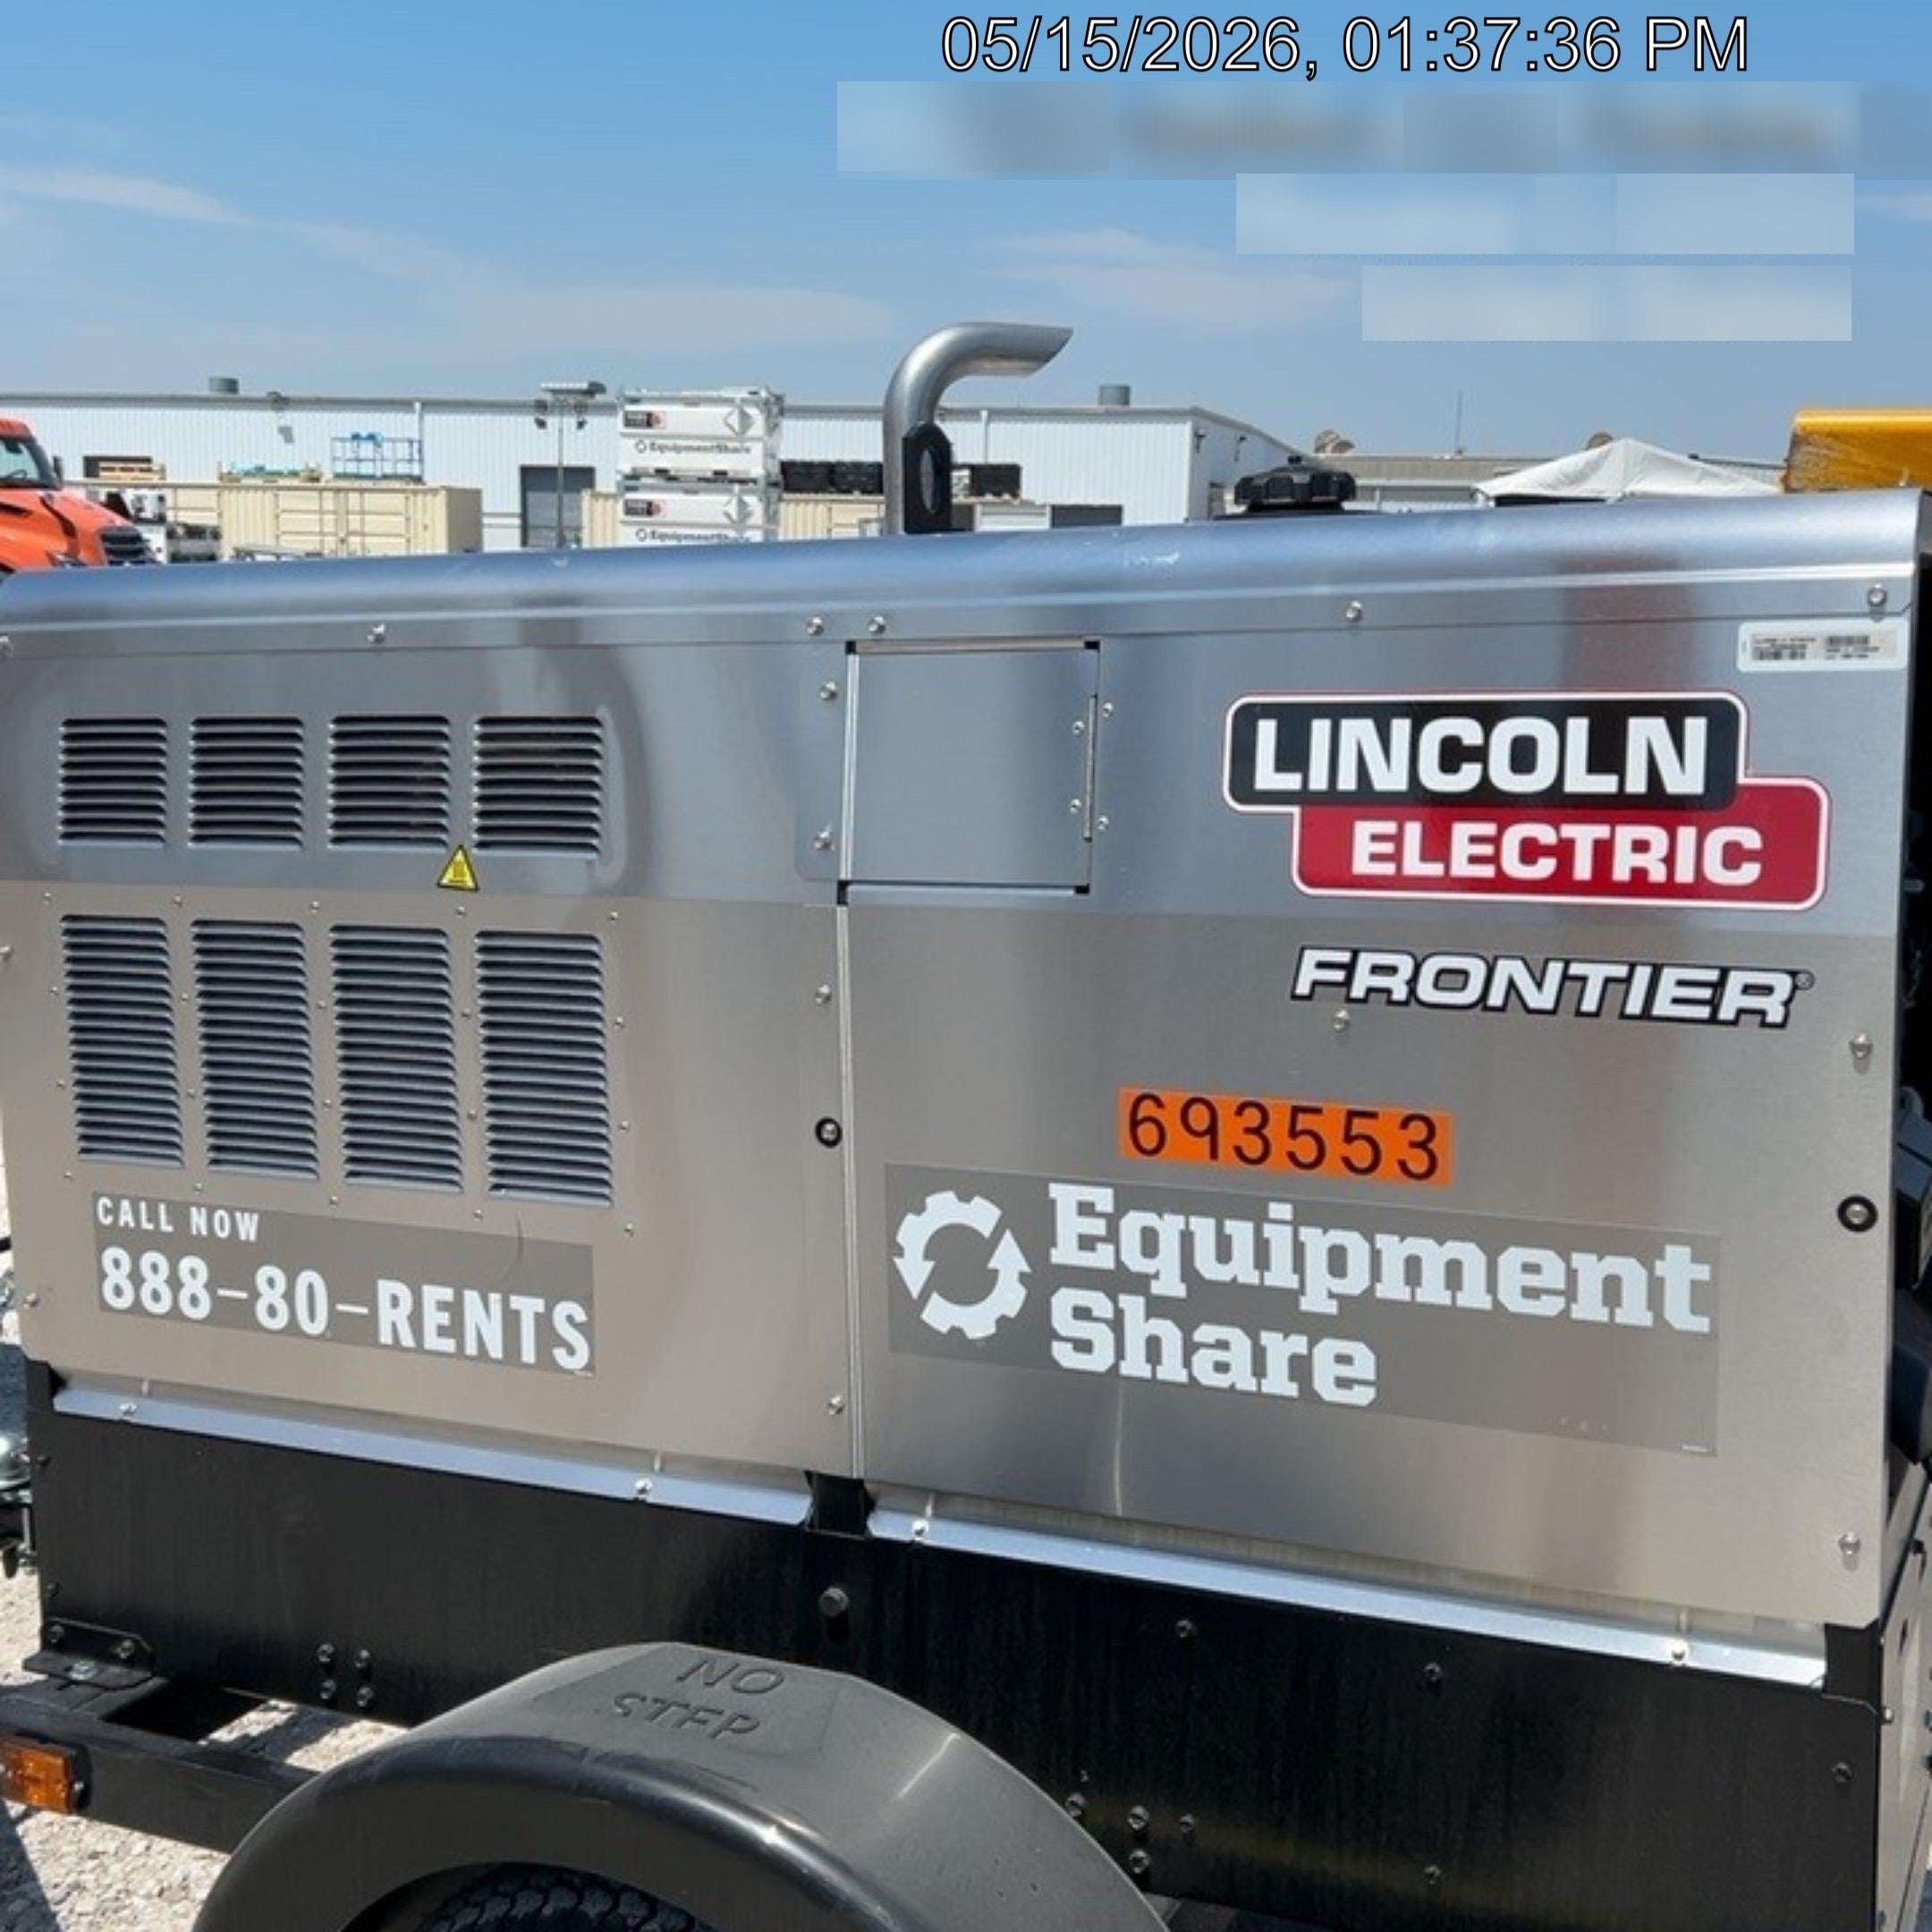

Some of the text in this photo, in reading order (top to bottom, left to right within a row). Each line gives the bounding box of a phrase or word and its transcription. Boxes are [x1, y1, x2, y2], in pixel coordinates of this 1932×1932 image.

[1254, 716, 1707, 795] LINCOLN
[1352, 820, 1762, 886] ELECTRIC
[1127, 1092, 1440, 1182] 693553
[97, 1197, 259, 1241] CALL NOW
[1048, 1182, 1711, 1333] Equipment
[100, 1246, 591, 1371] 888-80-RENTS
[1050, 1287, 1377, 1407] Share
[676, 1659, 784, 1694] NO
